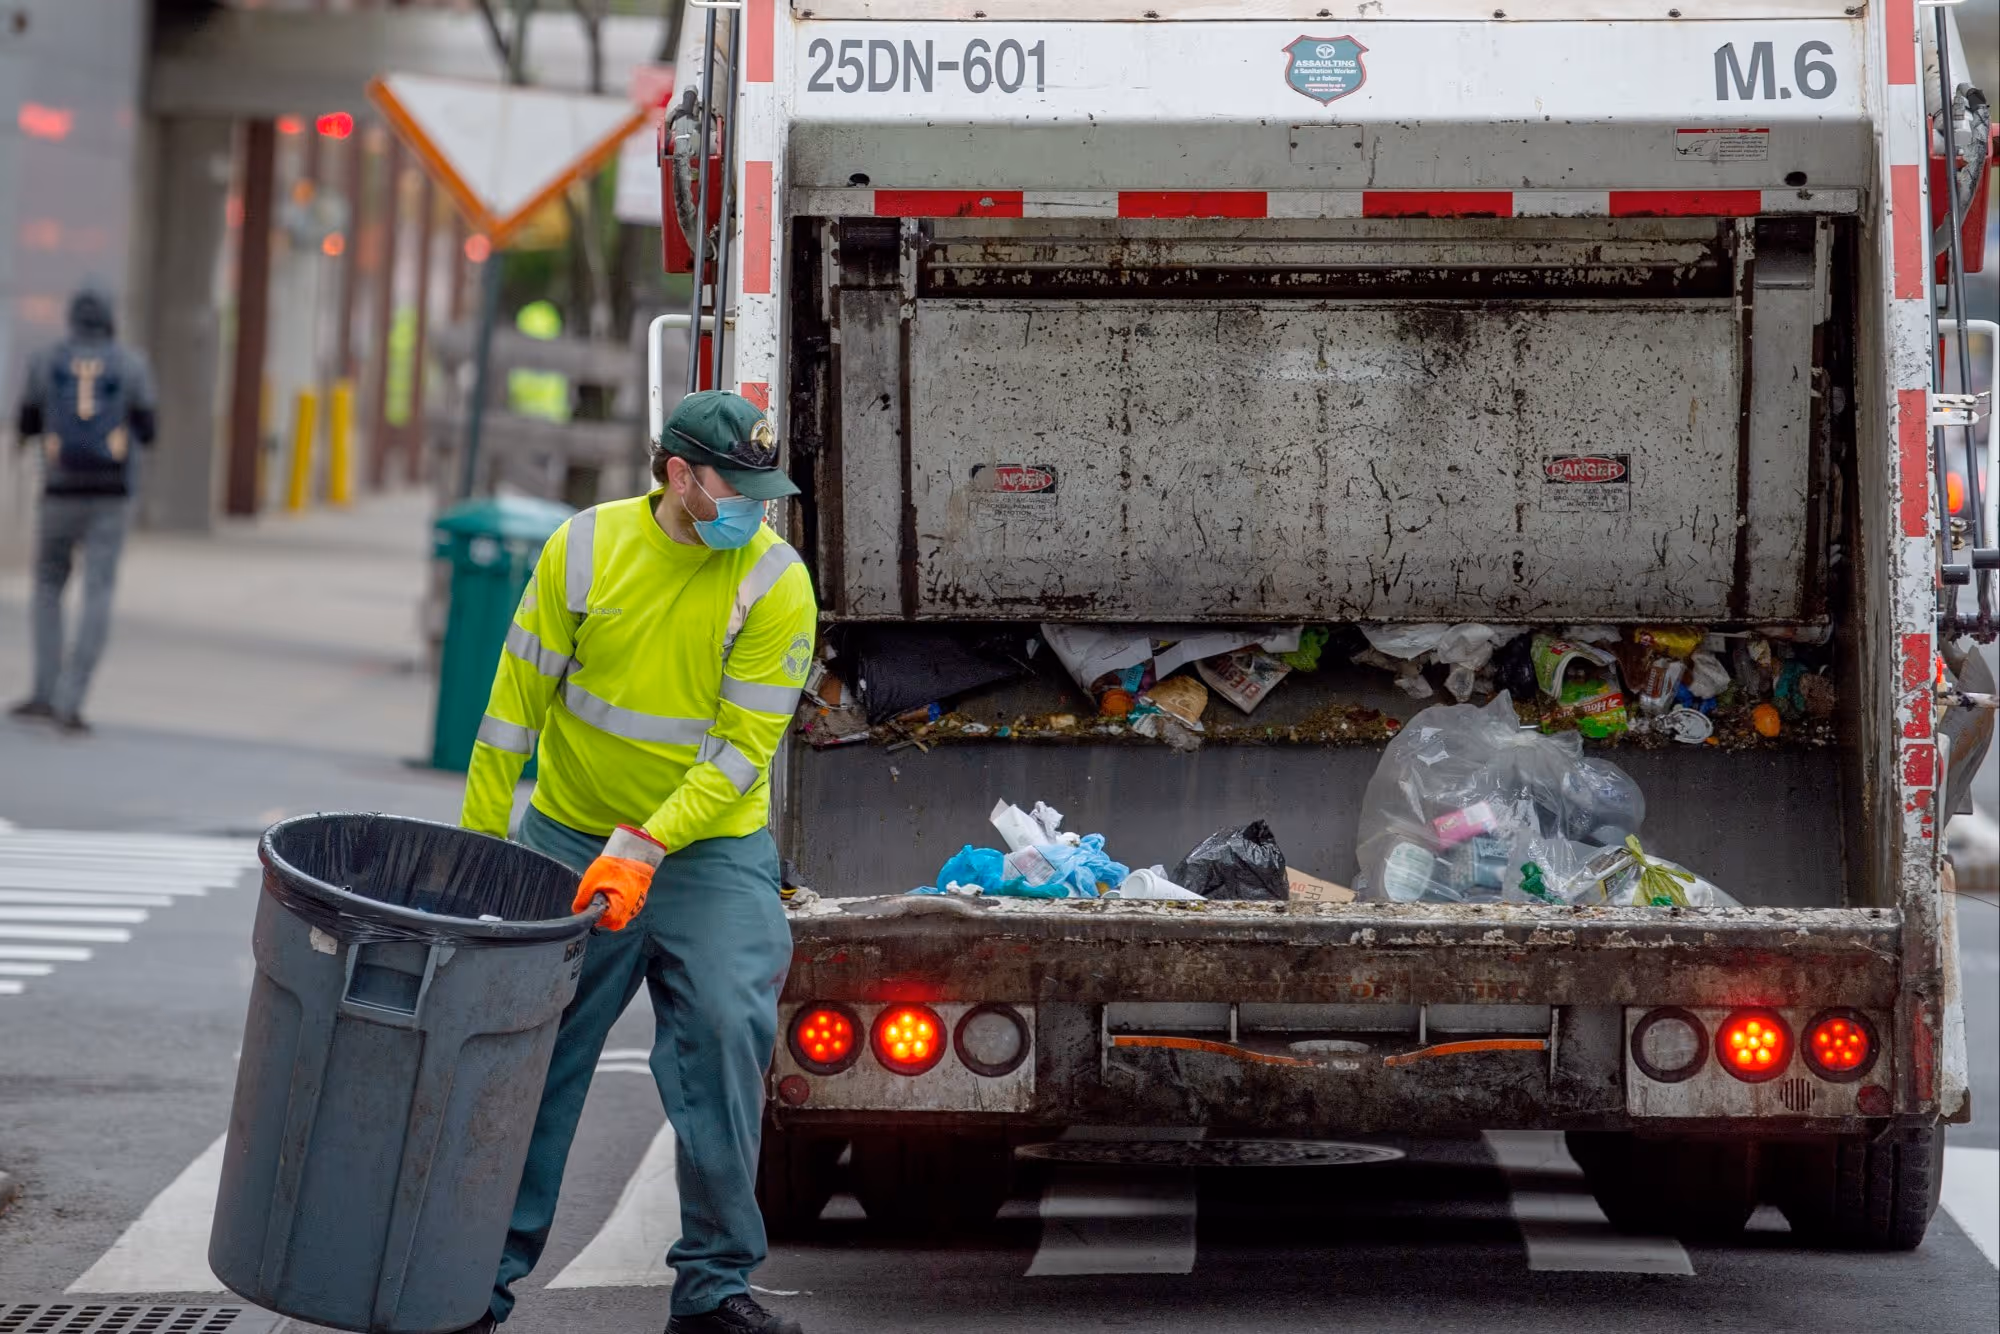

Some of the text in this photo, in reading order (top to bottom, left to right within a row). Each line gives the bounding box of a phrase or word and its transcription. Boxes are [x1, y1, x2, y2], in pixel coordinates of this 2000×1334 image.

[807, 38, 1045, 94] 25DN-601
[1295, 60, 1355, 68] ASSAULTING
[1714, 40, 1838, 101] M.6
[1551, 463, 1618, 477] DANGER
[993, 472, 1046, 488] ANGER
